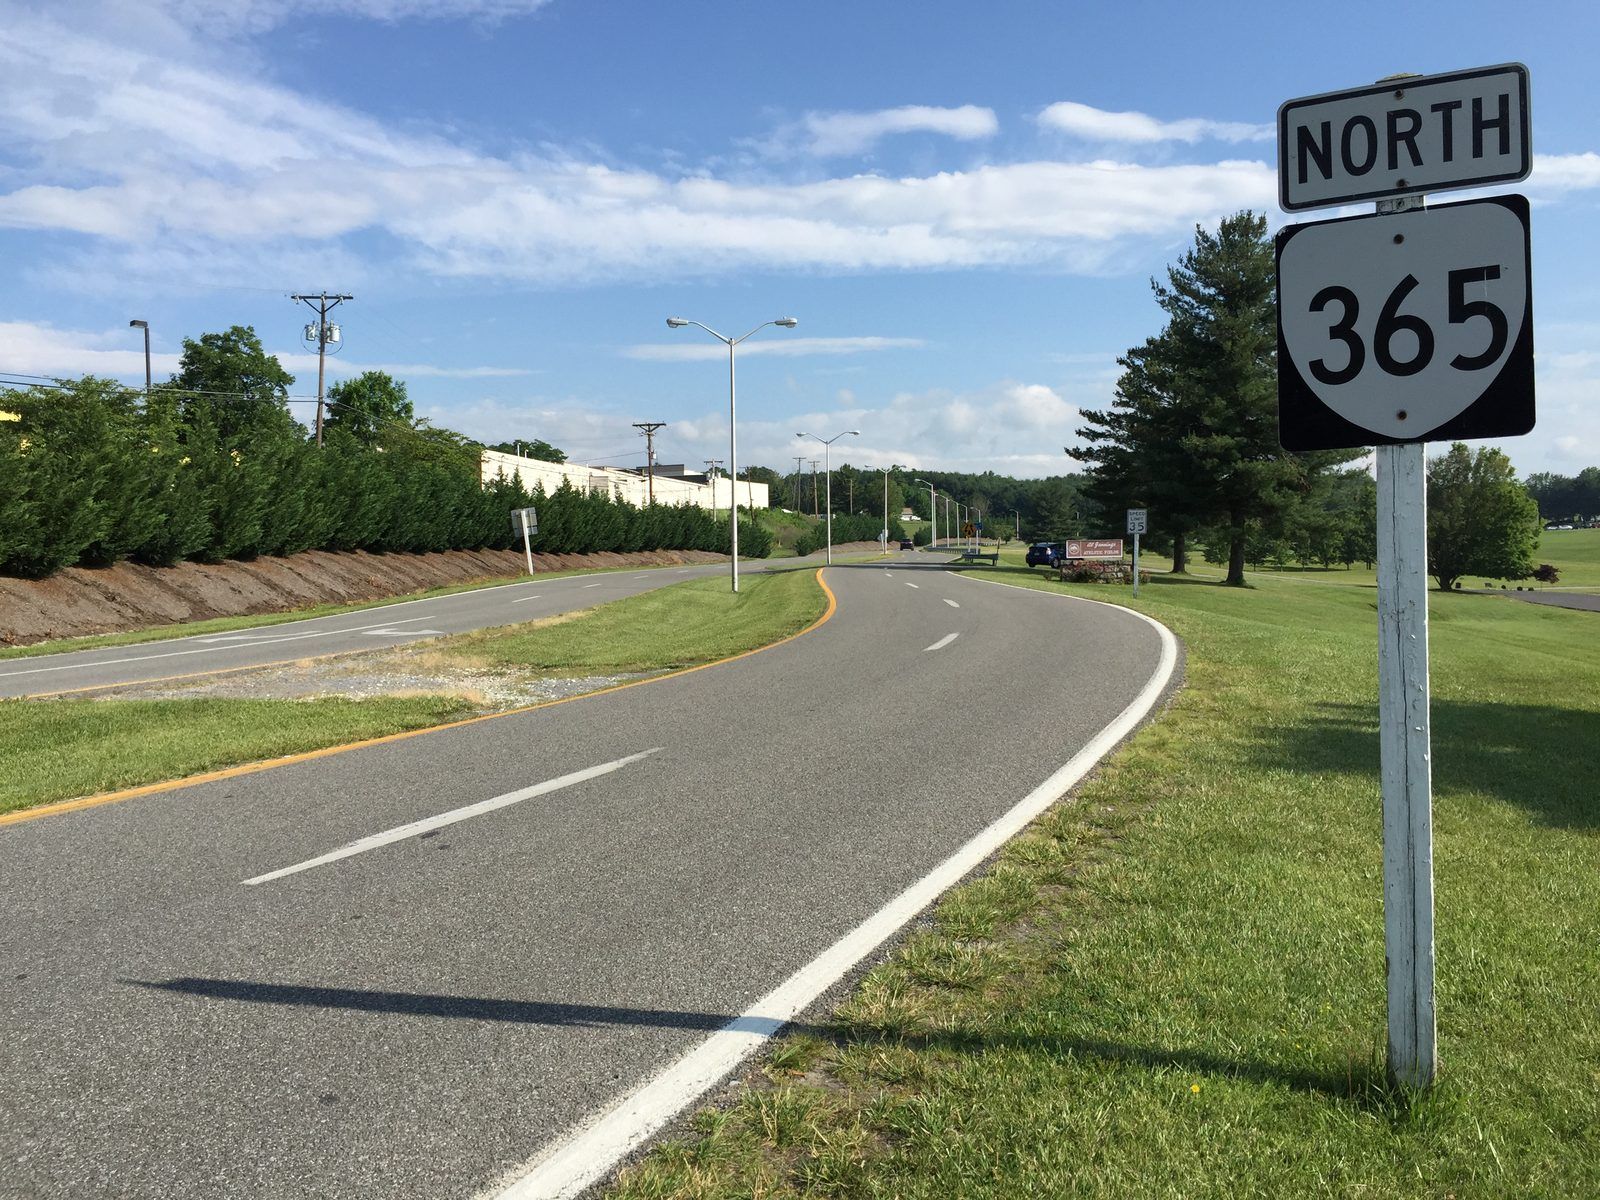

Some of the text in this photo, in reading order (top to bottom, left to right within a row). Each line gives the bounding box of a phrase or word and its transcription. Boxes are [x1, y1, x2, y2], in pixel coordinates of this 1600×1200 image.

[1297, 94, 1511, 184] NORTH
[1309, 265, 1508, 385] 365
[1129, 521, 1145, 531] 35
